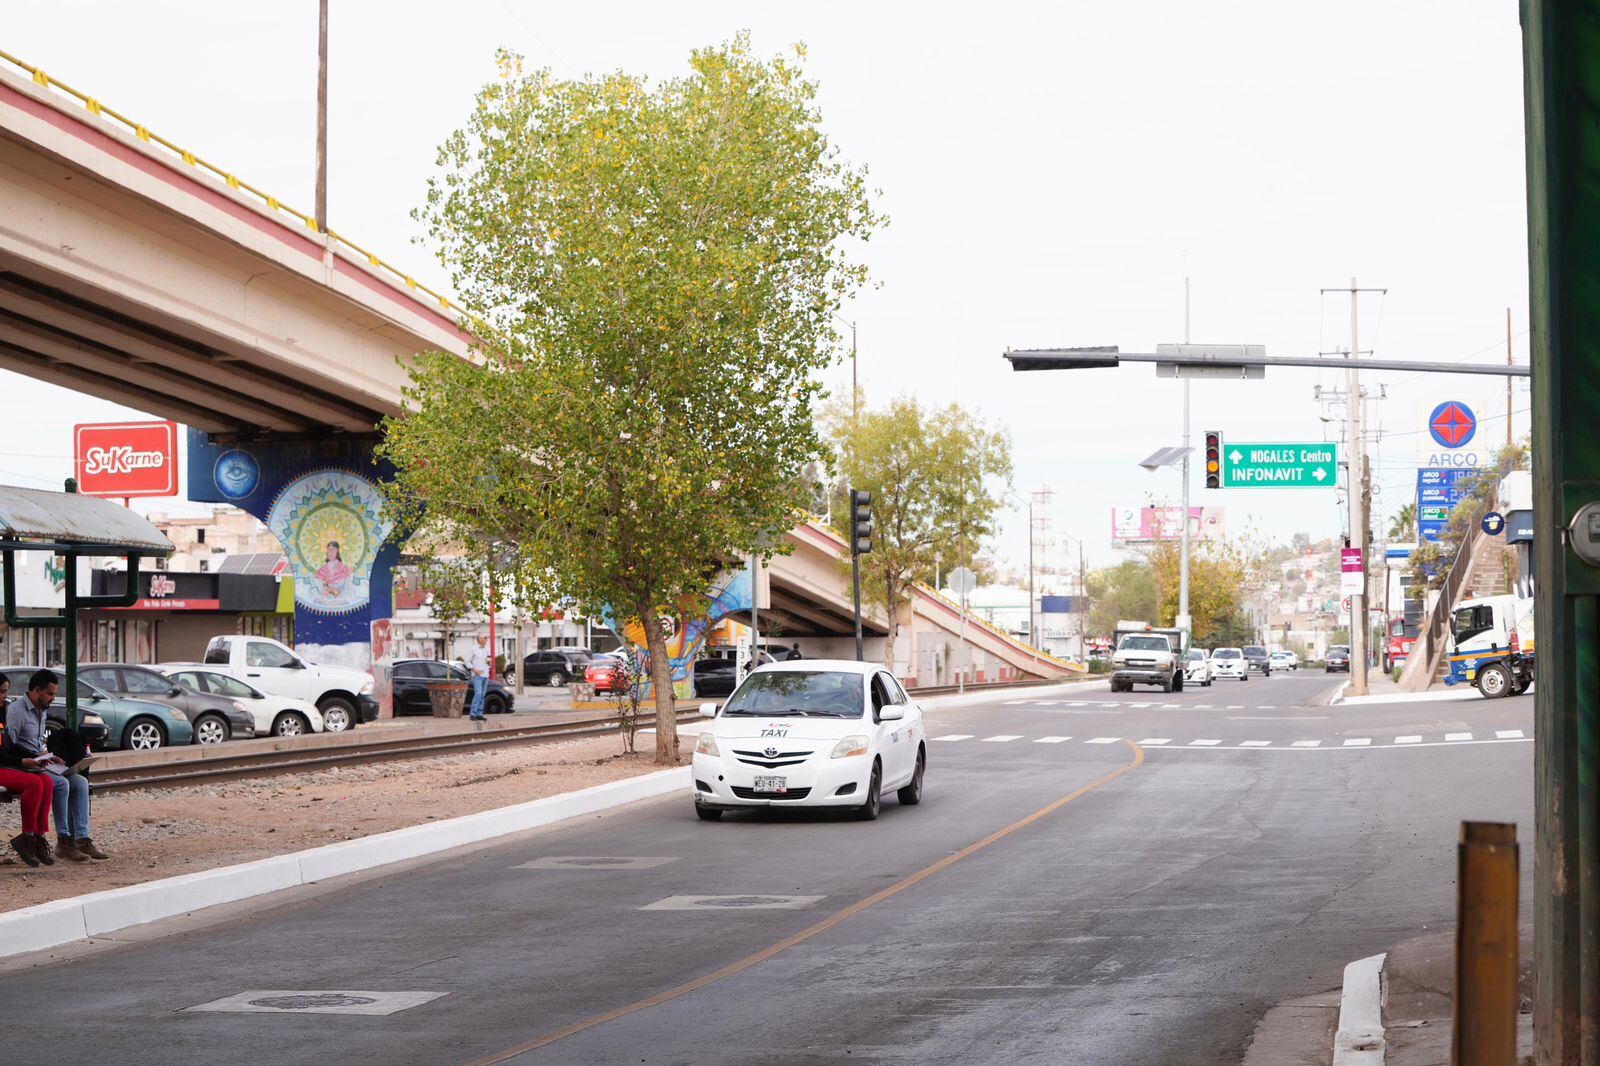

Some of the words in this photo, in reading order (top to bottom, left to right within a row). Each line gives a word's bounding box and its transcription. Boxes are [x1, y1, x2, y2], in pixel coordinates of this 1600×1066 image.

[85, 446, 163, 474] SuKarne
[1250, 449, 1295, 463] NOGALES
[1300, 450, 1332, 463] Centro
[1428, 453, 1477, 467] ARCO
[1232, 467, 1304, 481] INFONAVIT
[760, 729, 788, 737] TAXI
